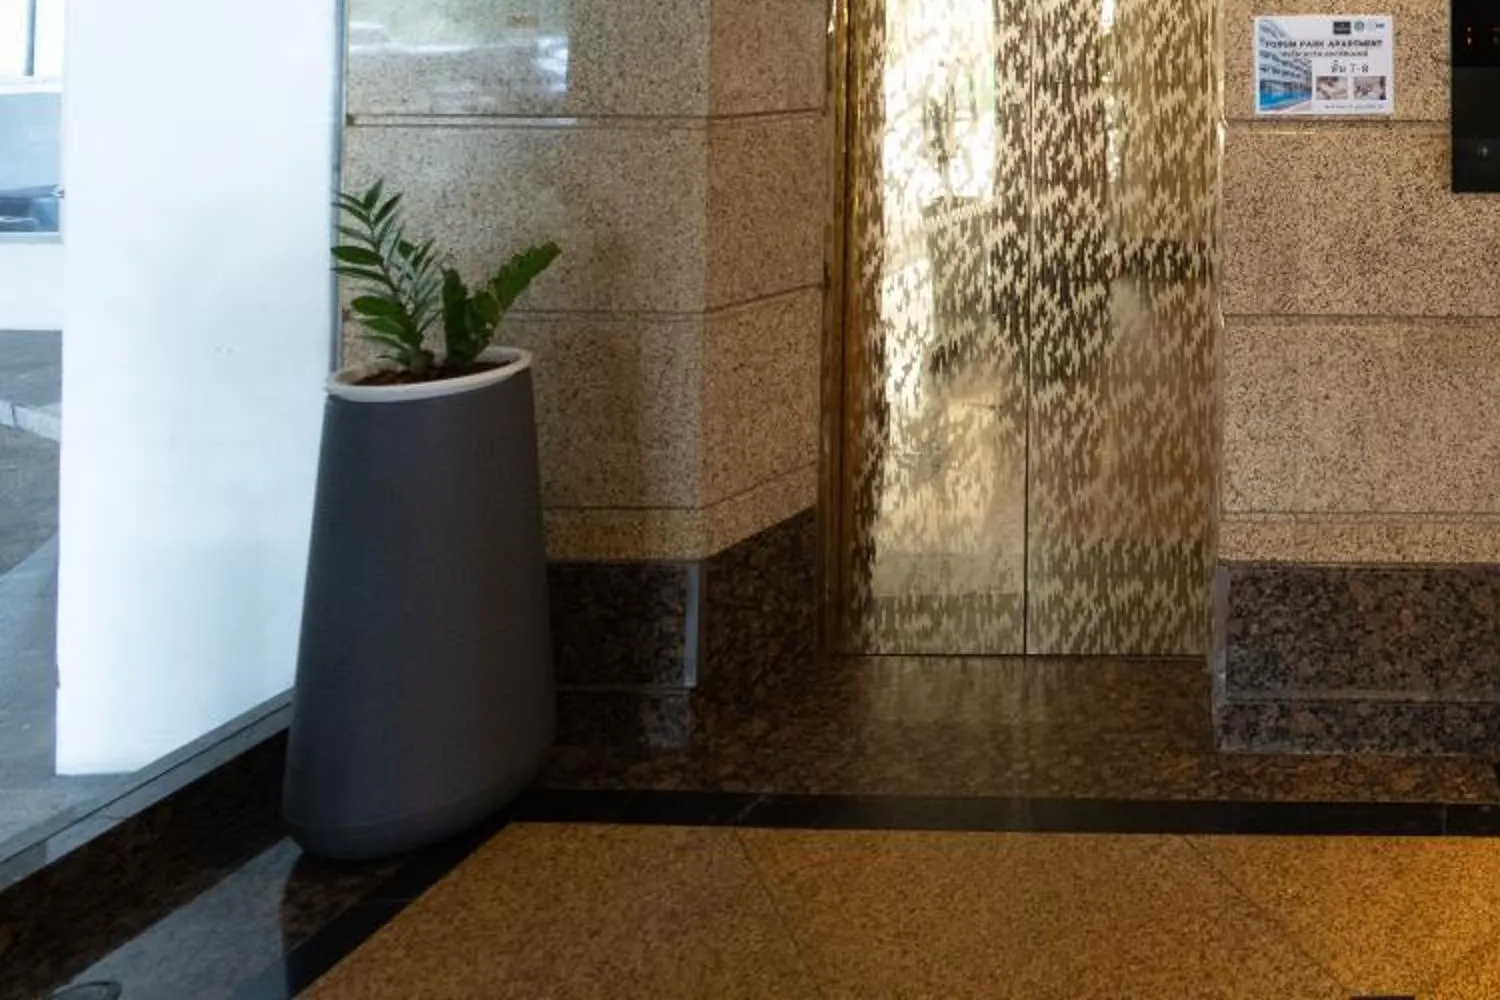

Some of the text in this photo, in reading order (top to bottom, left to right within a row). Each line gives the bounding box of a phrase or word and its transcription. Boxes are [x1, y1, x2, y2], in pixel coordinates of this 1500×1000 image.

[1264, 39, 1383, 49] FORUM PARK APARTMENT
